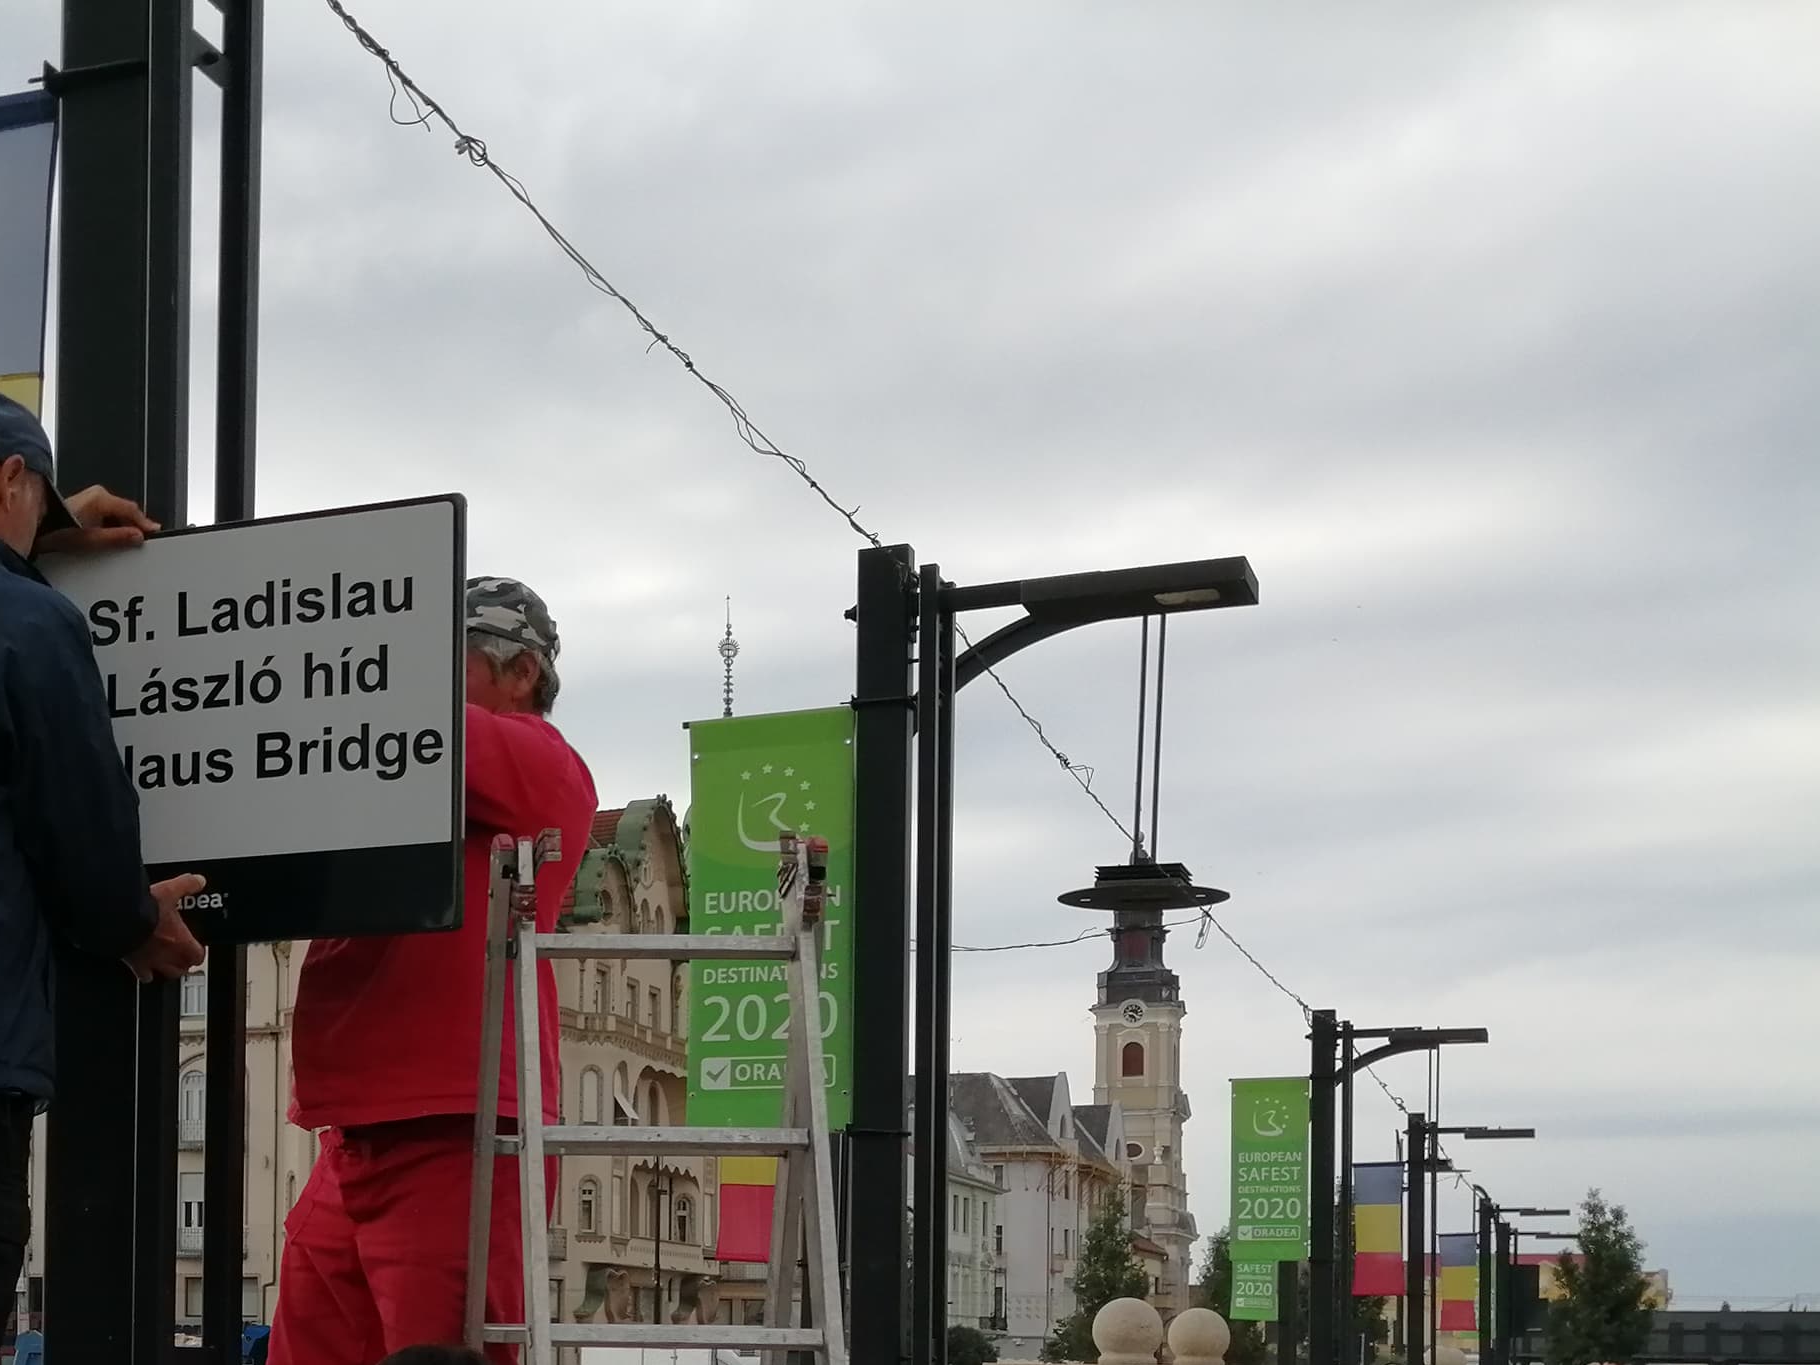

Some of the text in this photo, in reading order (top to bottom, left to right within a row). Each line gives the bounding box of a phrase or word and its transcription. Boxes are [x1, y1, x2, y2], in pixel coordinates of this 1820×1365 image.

[89, 572, 414, 646] Sf. Ladislau
[107, 644, 389, 718] László híd
[125, 723, 444, 790] laus Bridge
[701, 991, 838, 1042] 2020
[1238, 1152, 1302, 1163] EUROPEAN
[1238, 1166, 1301, 1181] SAFEST
[1238, 1198, 1301, 1219] 2020
[1253, 1228, 1297, 1237] ORADEA
[1236, 1263, 1272, 1273] SAFEST
[1236, 1281, 1272, 1296] 2020
